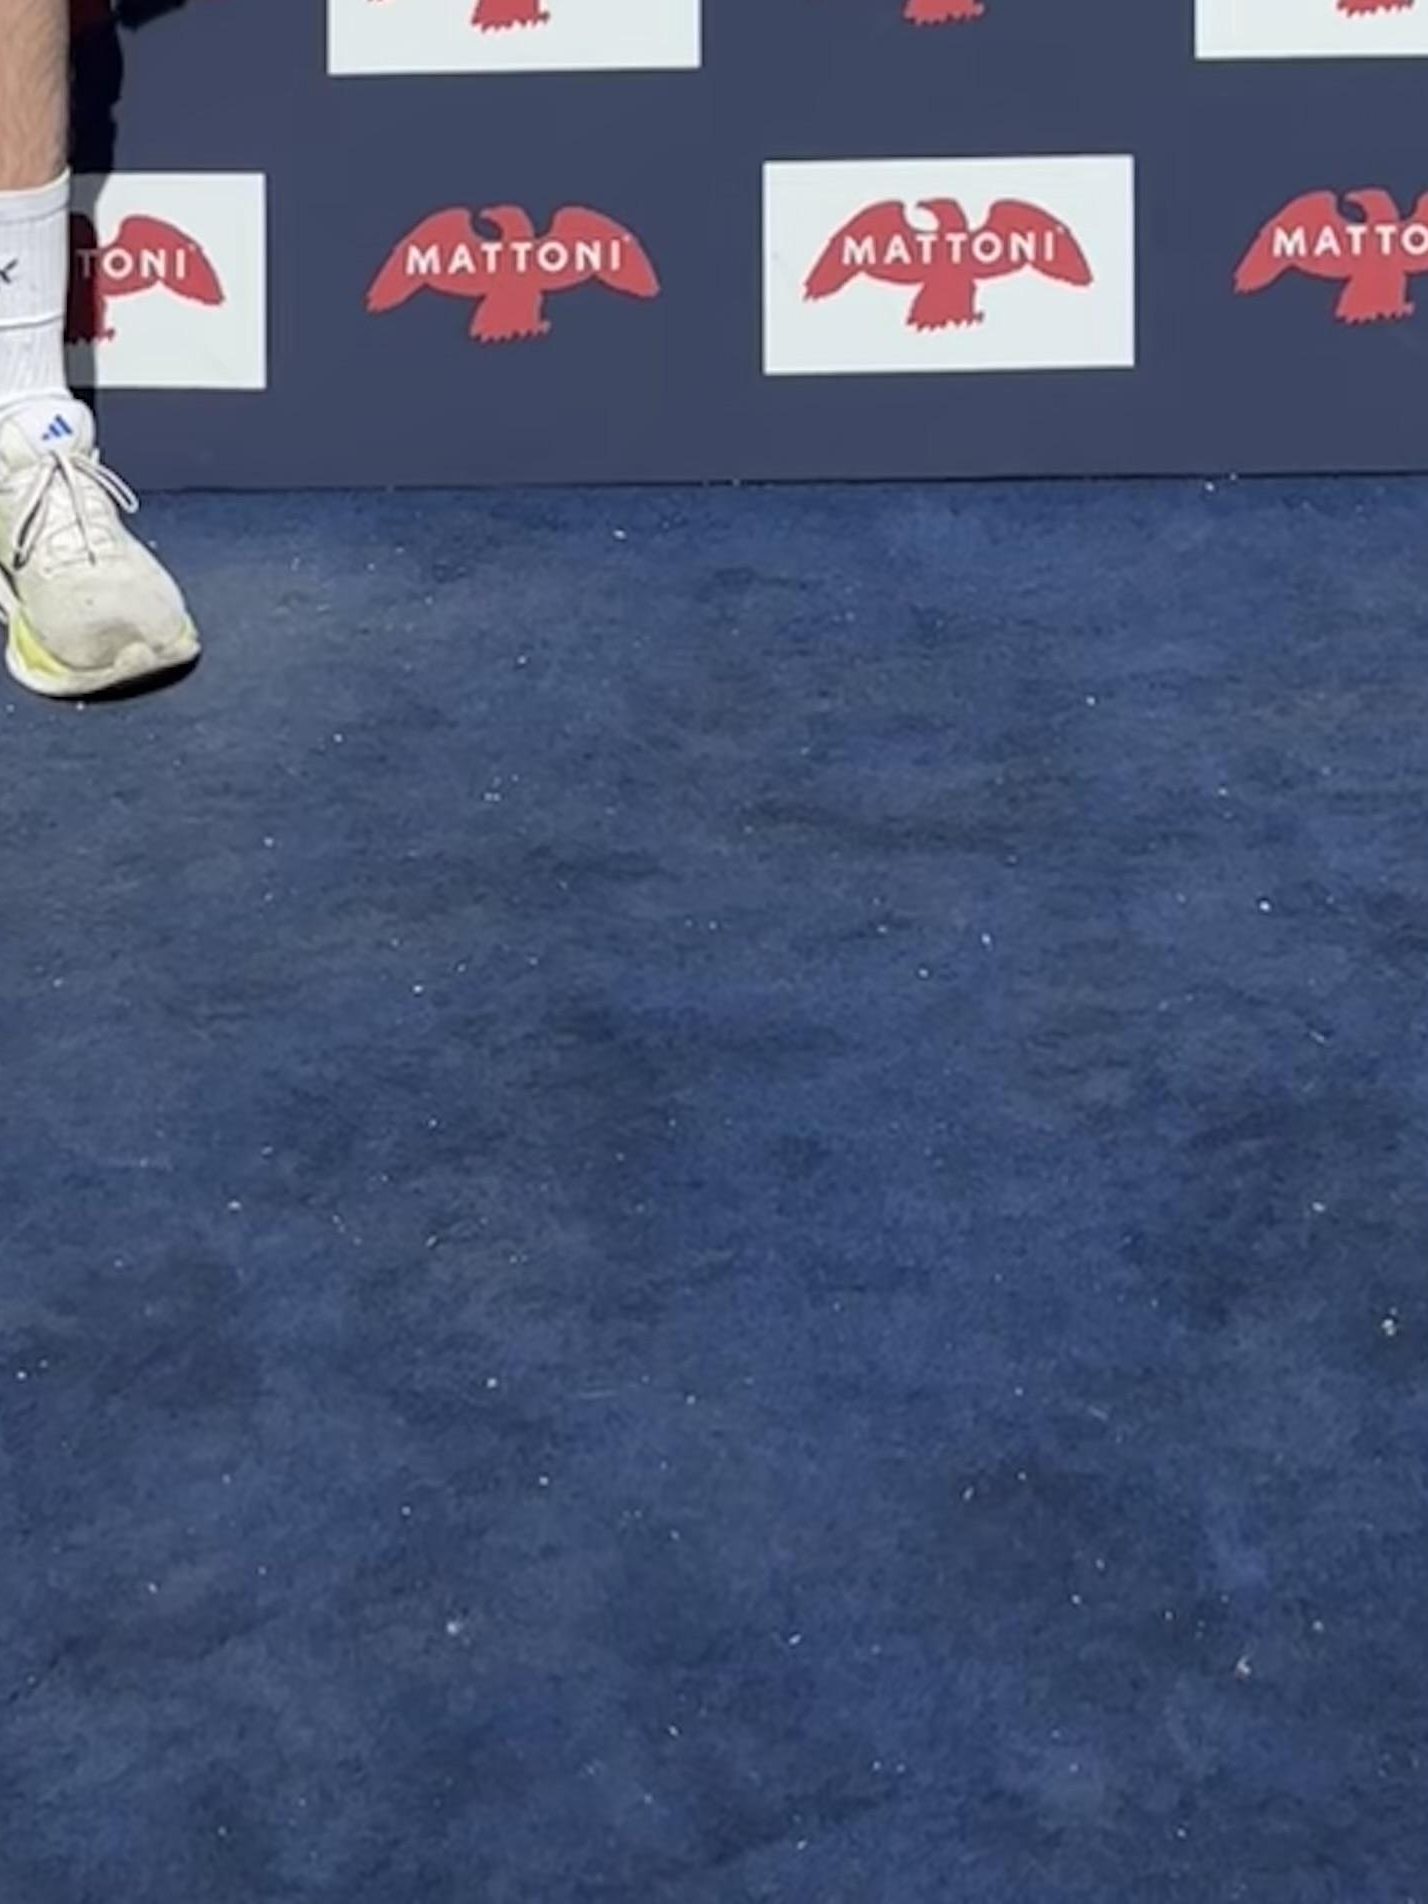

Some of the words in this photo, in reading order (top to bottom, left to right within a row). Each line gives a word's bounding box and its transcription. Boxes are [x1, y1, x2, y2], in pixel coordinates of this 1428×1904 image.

[76, 248, 185, 279] TONI
[406, 240, 620, 275] MATTONI
[842, 231, 1053, 265] MATTONI
